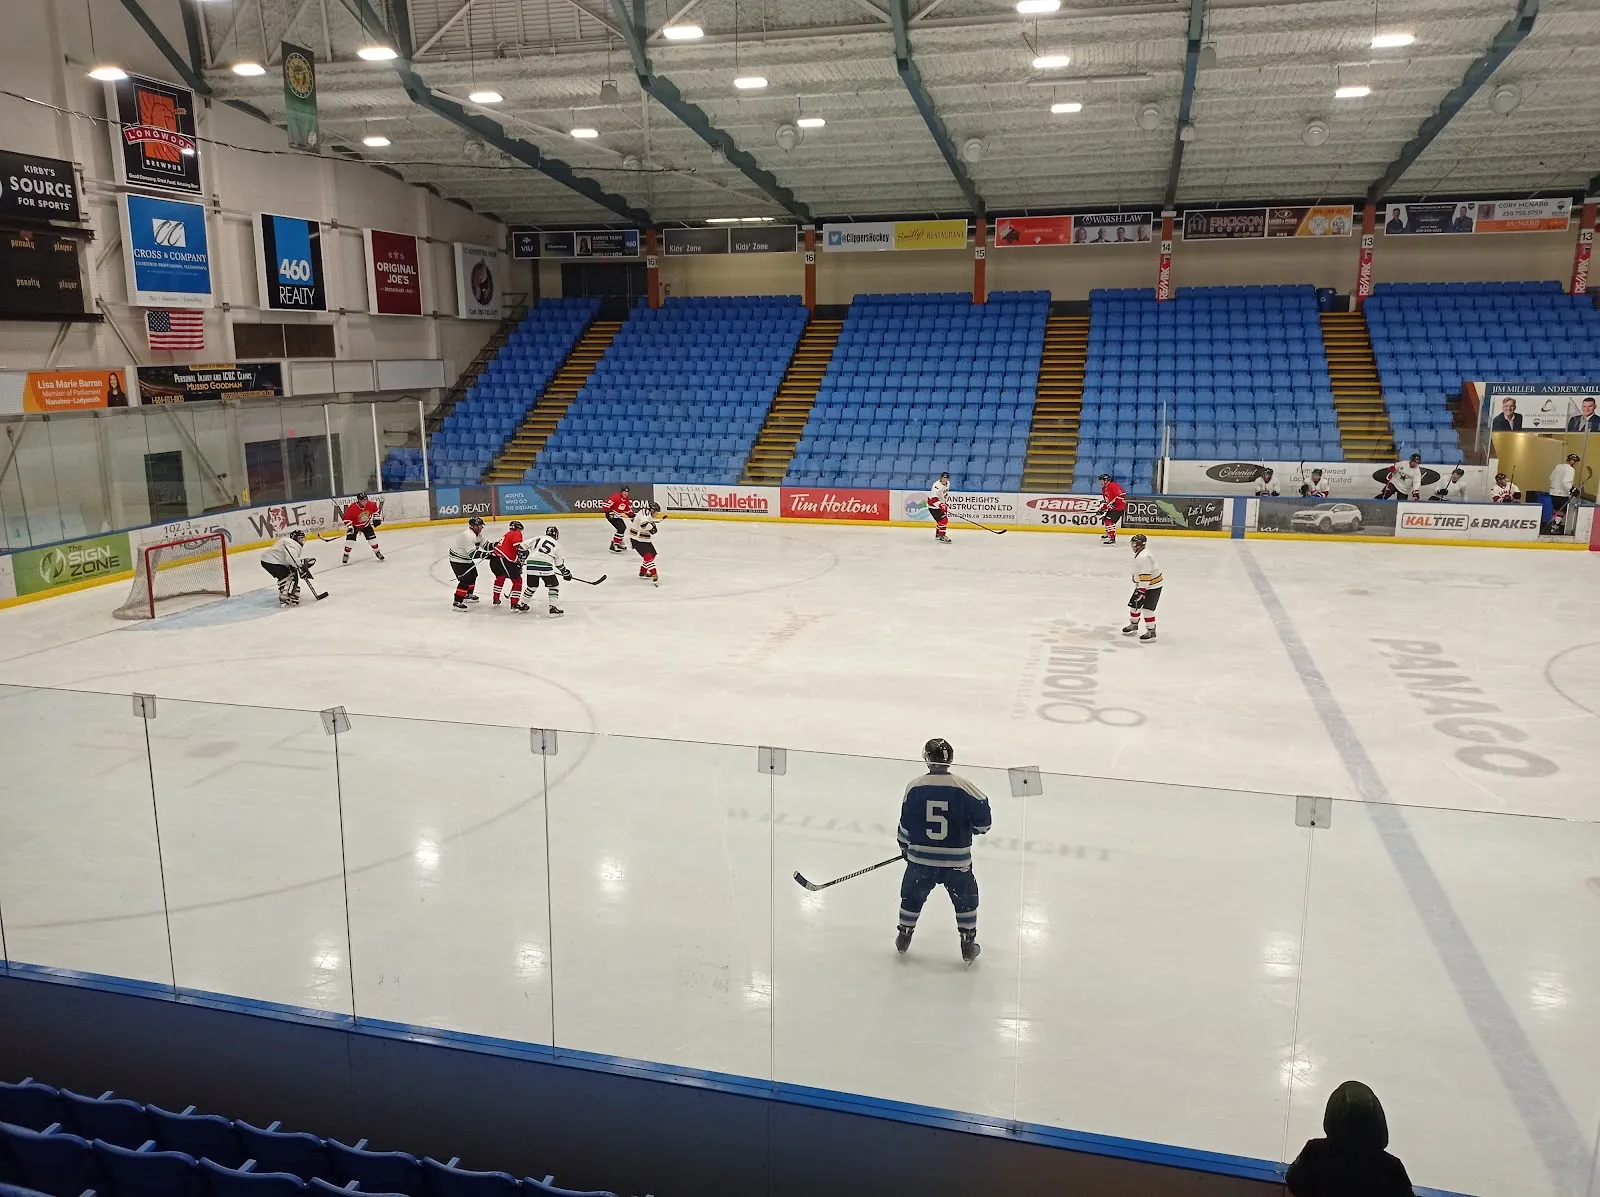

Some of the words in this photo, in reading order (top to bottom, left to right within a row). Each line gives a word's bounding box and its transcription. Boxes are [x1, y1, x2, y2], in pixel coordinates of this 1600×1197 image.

[24, 165, 56, 177] KIRBY'S
[146, 160, 181, 171] BREWPUB
[10, 176, 73, 198] SOURCE
[18, 197, 36, 207] FOR
[38, 199, 70, 211] SPORTS
[1092, 214, 1122, 224] WARSH
[1124, 214, 1143, 222] LAW
[1209, 216, 1264, 227] ERICKSON
[1364, 237, 1373, 246] 13
[1581, 232, 1593, 241] 13
[686, 244, 702, 252] Zone
[752, 242, 769, 250] Zone
[1162, 243, 1170, 251] 14
[134, 249, 162, 259] CROSS
[170, 252, 207, 263] COMPANY
[805, 254, 814, 262] 16
[975, 250, 985, 258] 15
[280, 258, 311, 282] 460
[377, 261, 417, 275] ORIGINAL
[387, 274, 410, 285] JOE'S
[1359, 262, 1371, 296] RE/MAX
[1574, 258, 1590, 294] RE/MAX
[16, 278, 41, 288] penalty
[1159, 267, 1170, 299] RE/MAX
[280, 286, 315, 305] REALTY
[38, 380, 54, 389] Lisa
[56, 380, 77, 388] Marie
[187, 382, 209, 391] MUSSIO
[210, 381, 242, 389] GOODMAN
[1492, 386, 1506, 394] JIM
[1218, 467, 1257, 478] Colonial
[667, 492, 708, 507] NEWS
[707, 493, 768, 509] Bulletin
[790, 493, 817, 512] Tim
[820, 493, 878, 515] Hortons
[1035, 499, 1100, 512] panag
[440, 505, 459, 514] 460
[462, 503, 491, 513] REALTY
[947, 503, 996, 511] NSTRUCTION
[1127, 503, 1157, 515] DRG
[1205, 502, 1216, 512] Go
[301, 517, 324, 526] 106.9
[1470, 518, 1479, 528] &
[1481, 519, 1538, 529] BRAKES
[164, 521, 191, 534] 102.3
[68, 545, 111, 565] SIGN
[70, 556, 121, 577] ZONE
[1369, 637, 1560, 778] PANAGO
[925, 800, 949, 841] 5
